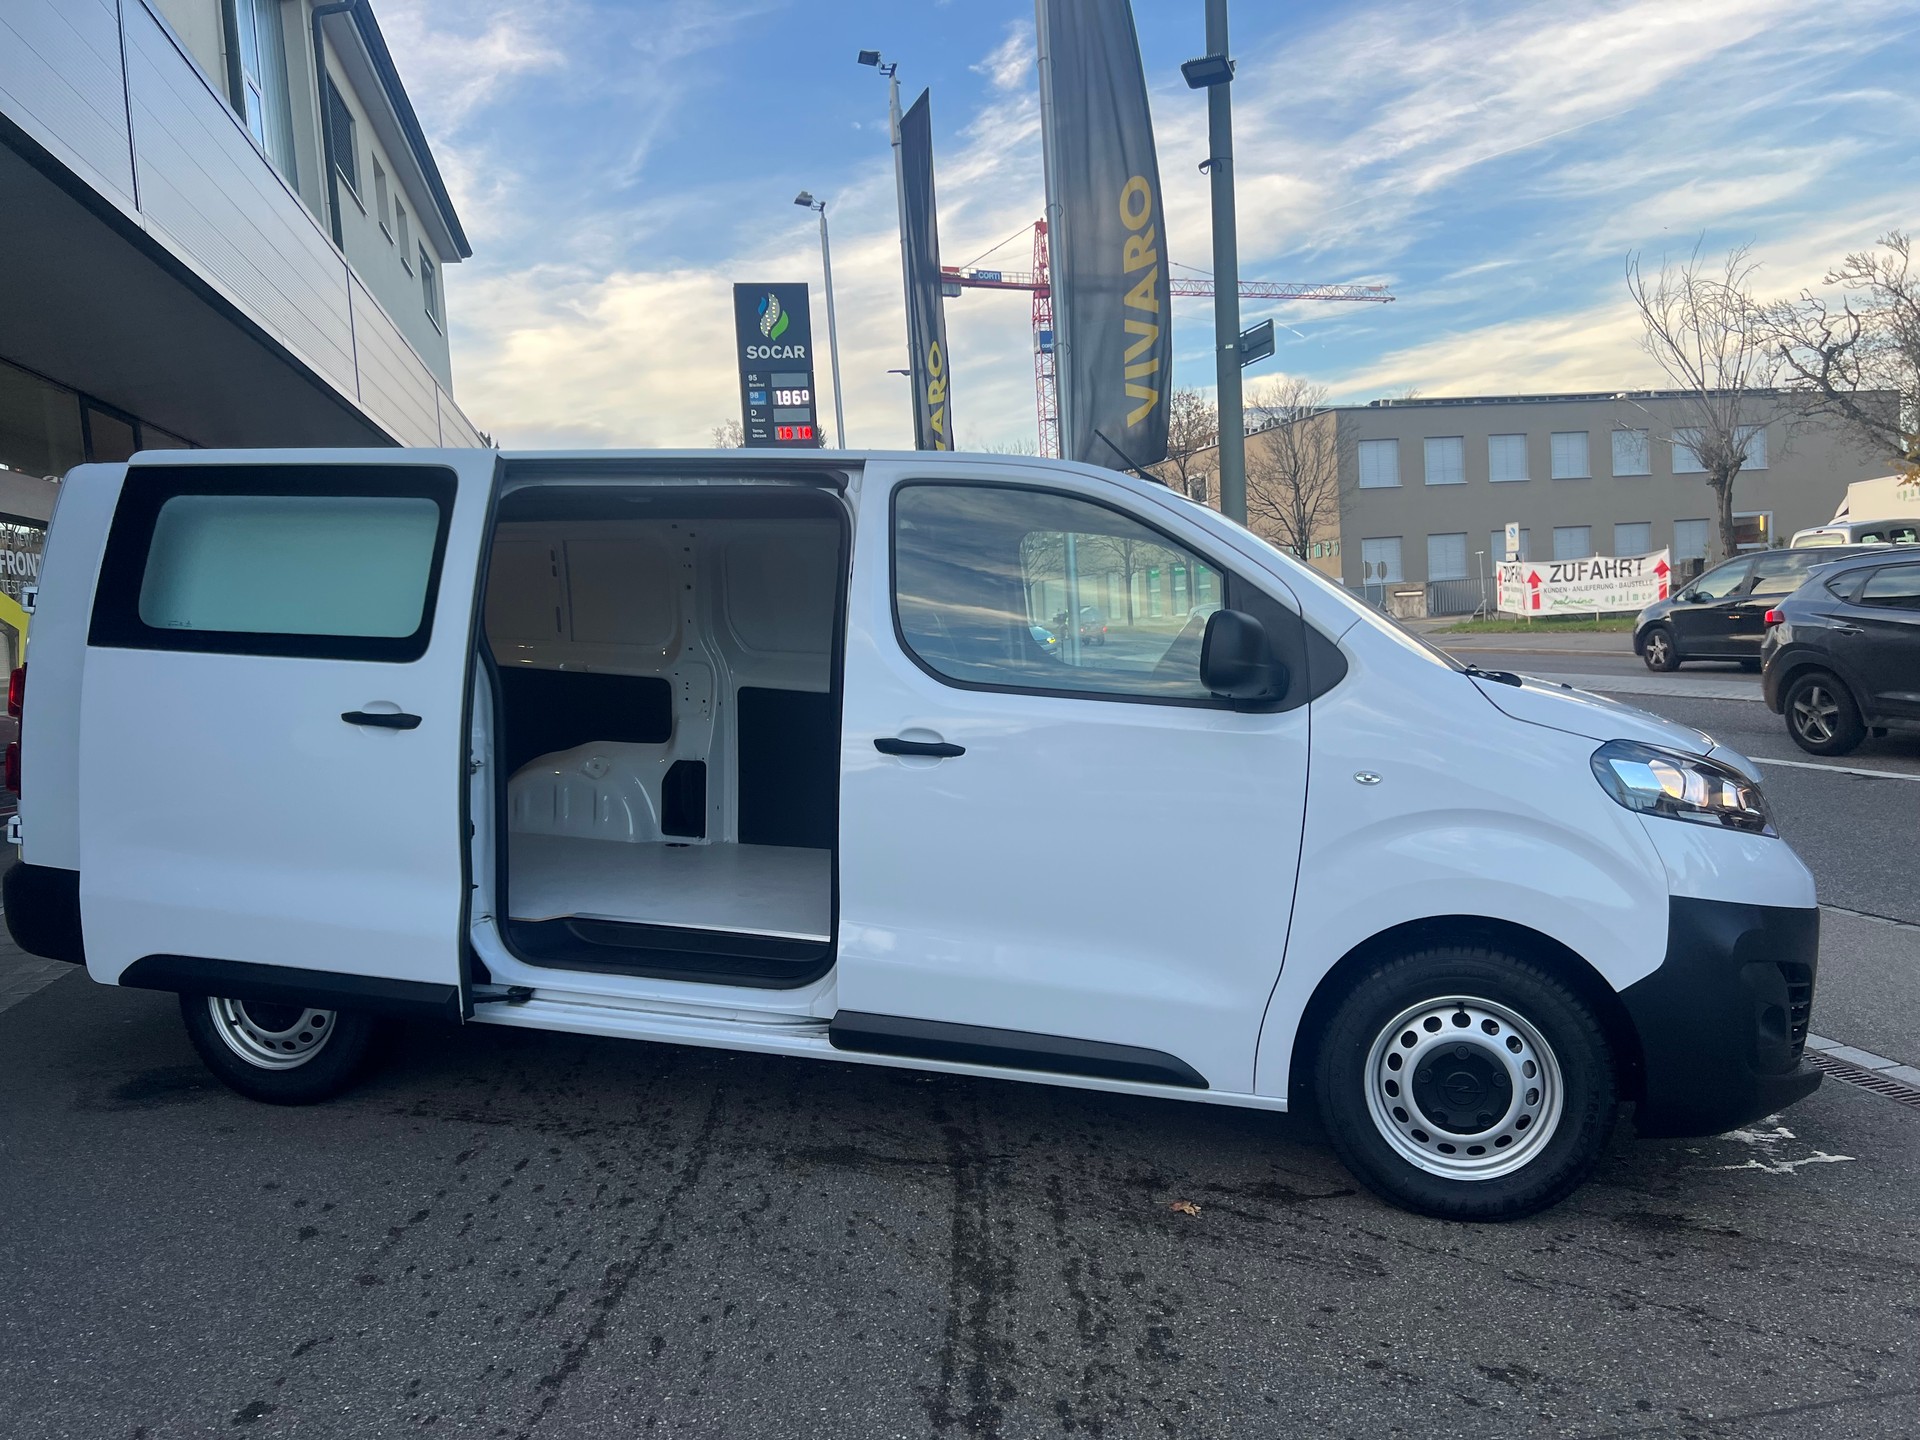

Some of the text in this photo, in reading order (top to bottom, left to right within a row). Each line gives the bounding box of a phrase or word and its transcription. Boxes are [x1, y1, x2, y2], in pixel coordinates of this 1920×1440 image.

[978, 271, 1000, 280] CORTI
[1119, 175, 1158, 428] VIVARO
[746, 345, 805, 359] SOCAR
[750, 391, 759, 399] 98
[927, 340, 947, 451] ARO
[1549, 557, 1646, 583] ZUFAHRT
[1572, 583, 1614, 592] ANLIEFERUNG
[1619, 579, 1653, 588] BAUSTELLE
